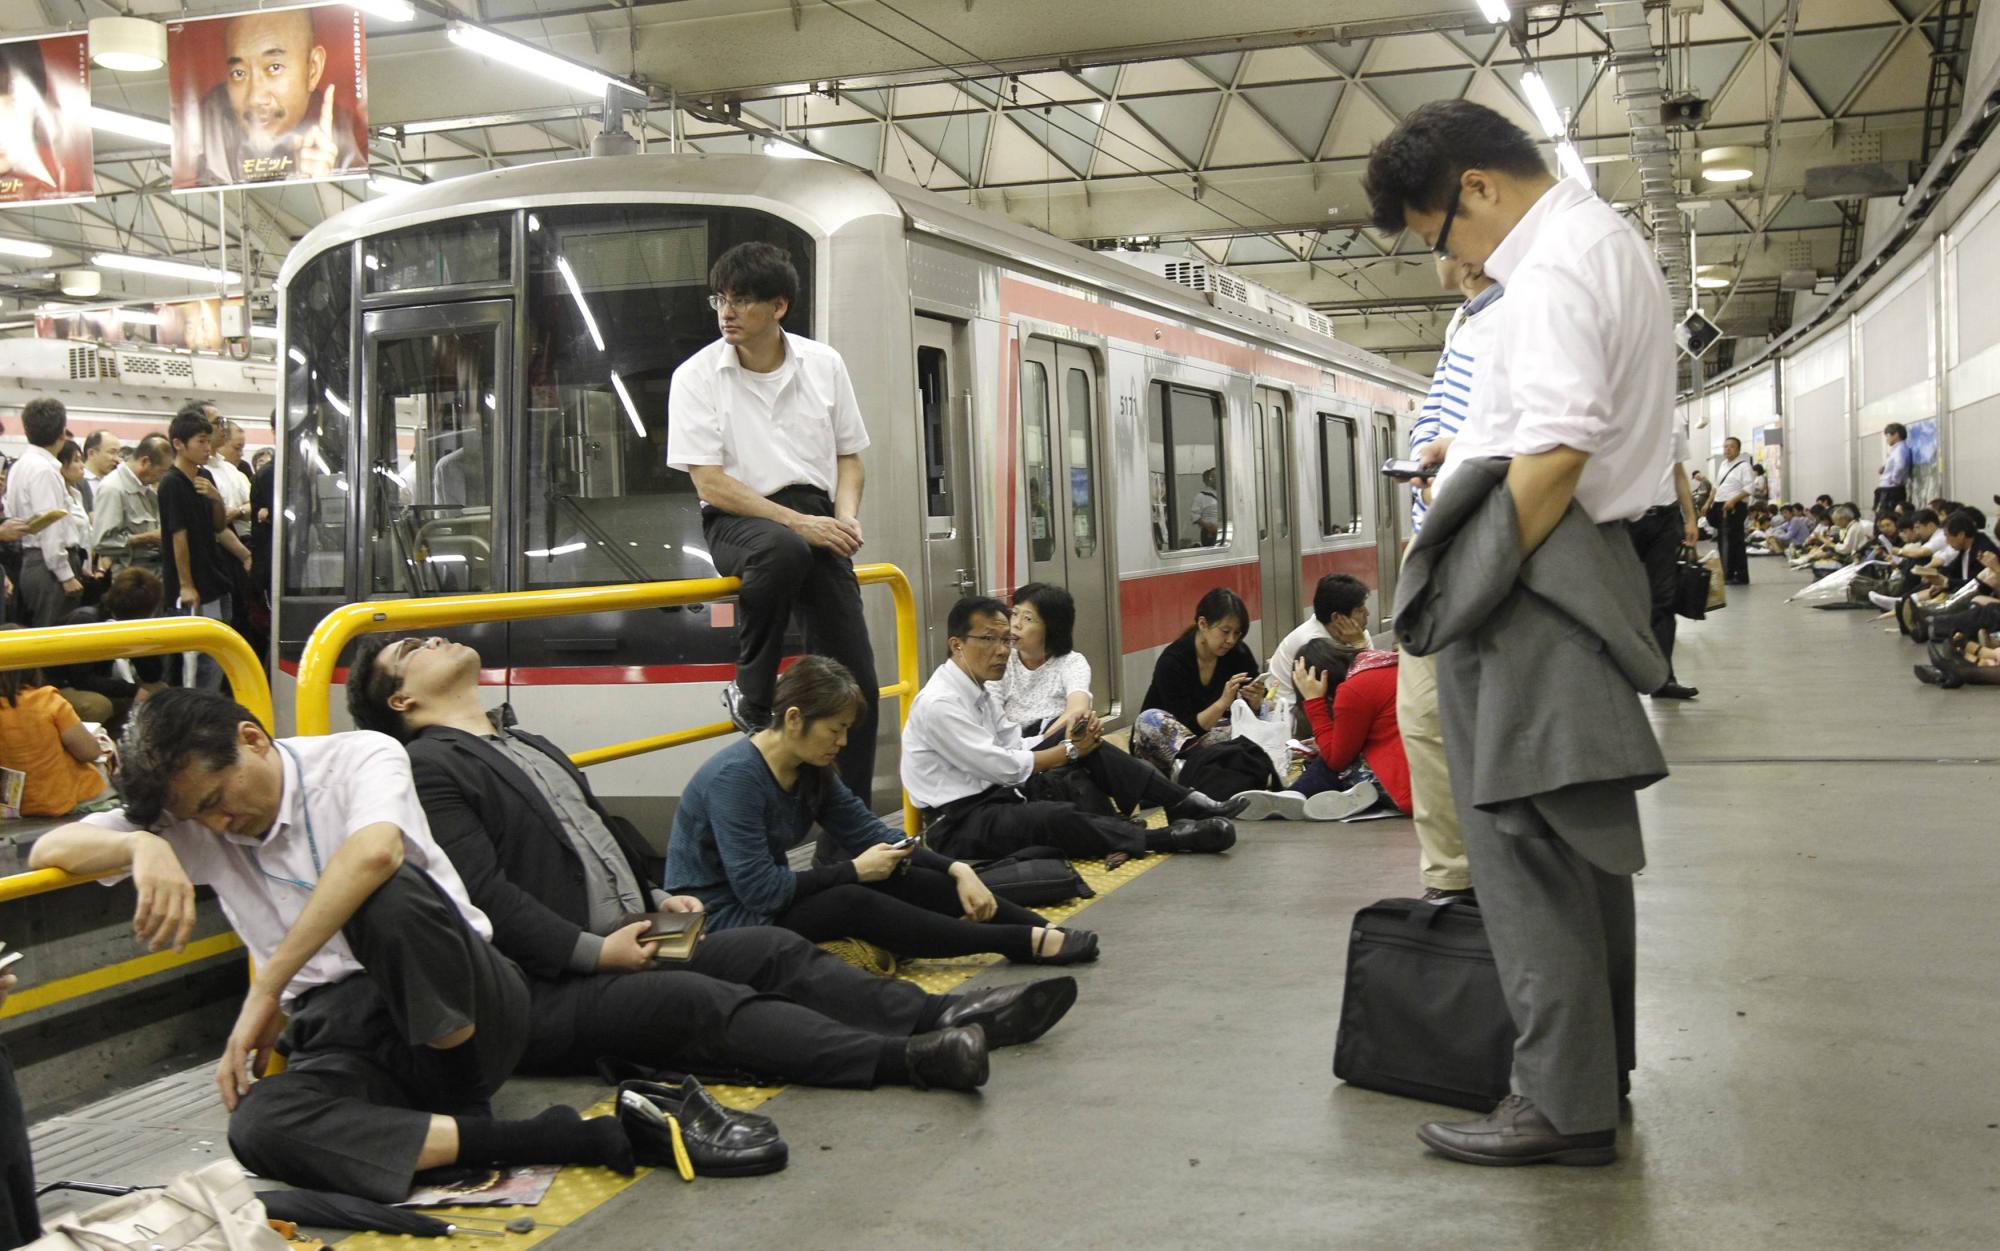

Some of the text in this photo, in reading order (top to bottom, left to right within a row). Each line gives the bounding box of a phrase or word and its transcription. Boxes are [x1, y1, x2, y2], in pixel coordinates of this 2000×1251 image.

[243, 155, 293, 173] モビット
[0, 178, 24, 193] ット
